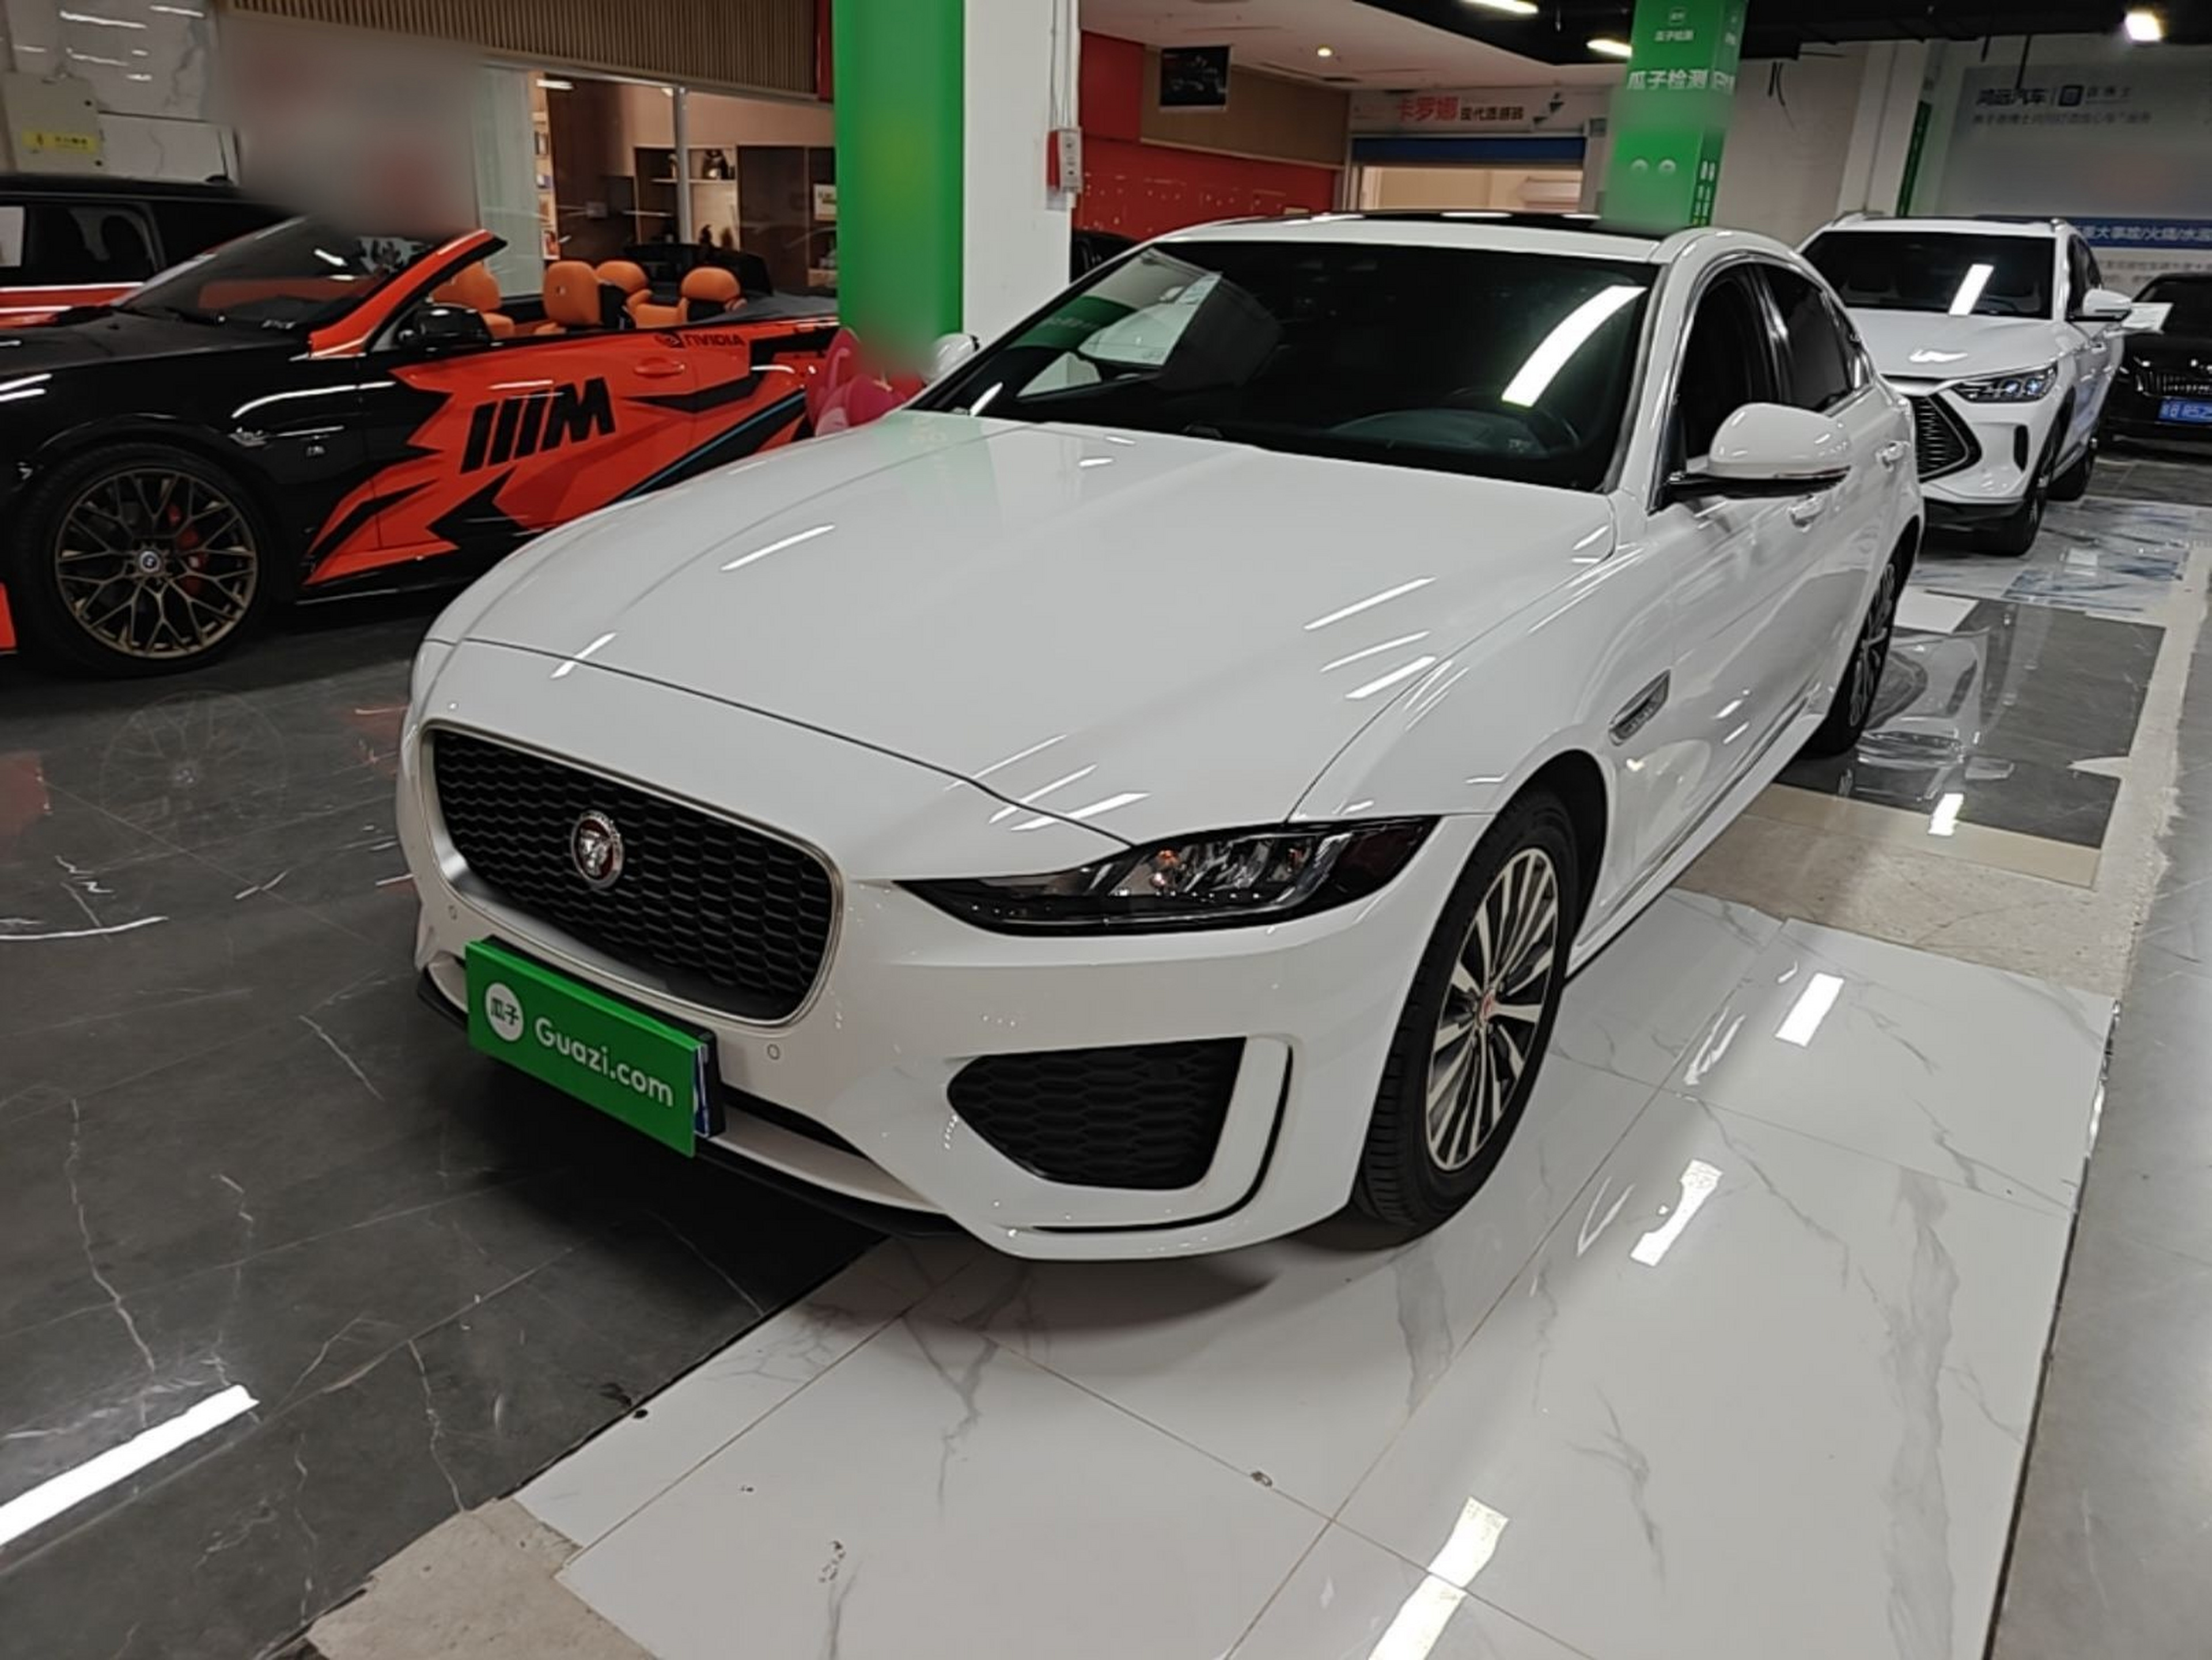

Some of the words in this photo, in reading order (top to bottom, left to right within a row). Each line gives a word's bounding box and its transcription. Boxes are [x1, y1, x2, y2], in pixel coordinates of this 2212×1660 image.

[1627, 69, 1709, 90] 瓜子检测
[534, 1017, 674, 1109] Guazi.com
